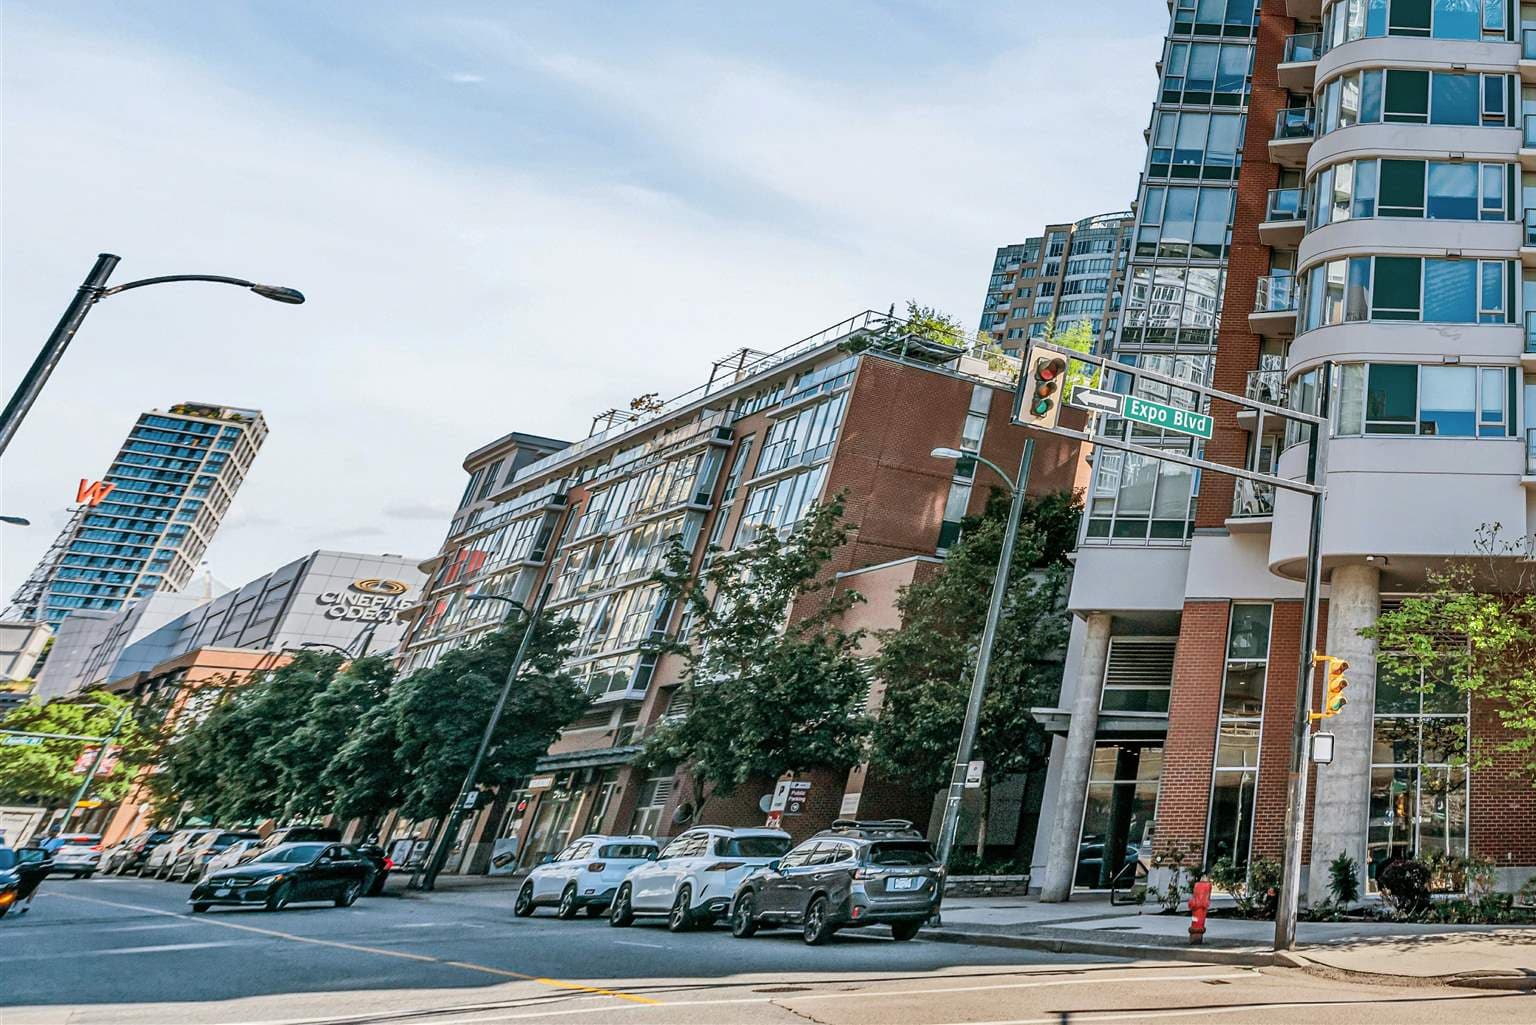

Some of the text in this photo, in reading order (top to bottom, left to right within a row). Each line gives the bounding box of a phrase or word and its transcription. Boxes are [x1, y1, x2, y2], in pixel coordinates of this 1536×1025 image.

[1131, 400, 1206, 432] Expo Blvd
[76, 479, 116, 507] W
[318, 592, 413, 610] CINEPLE
